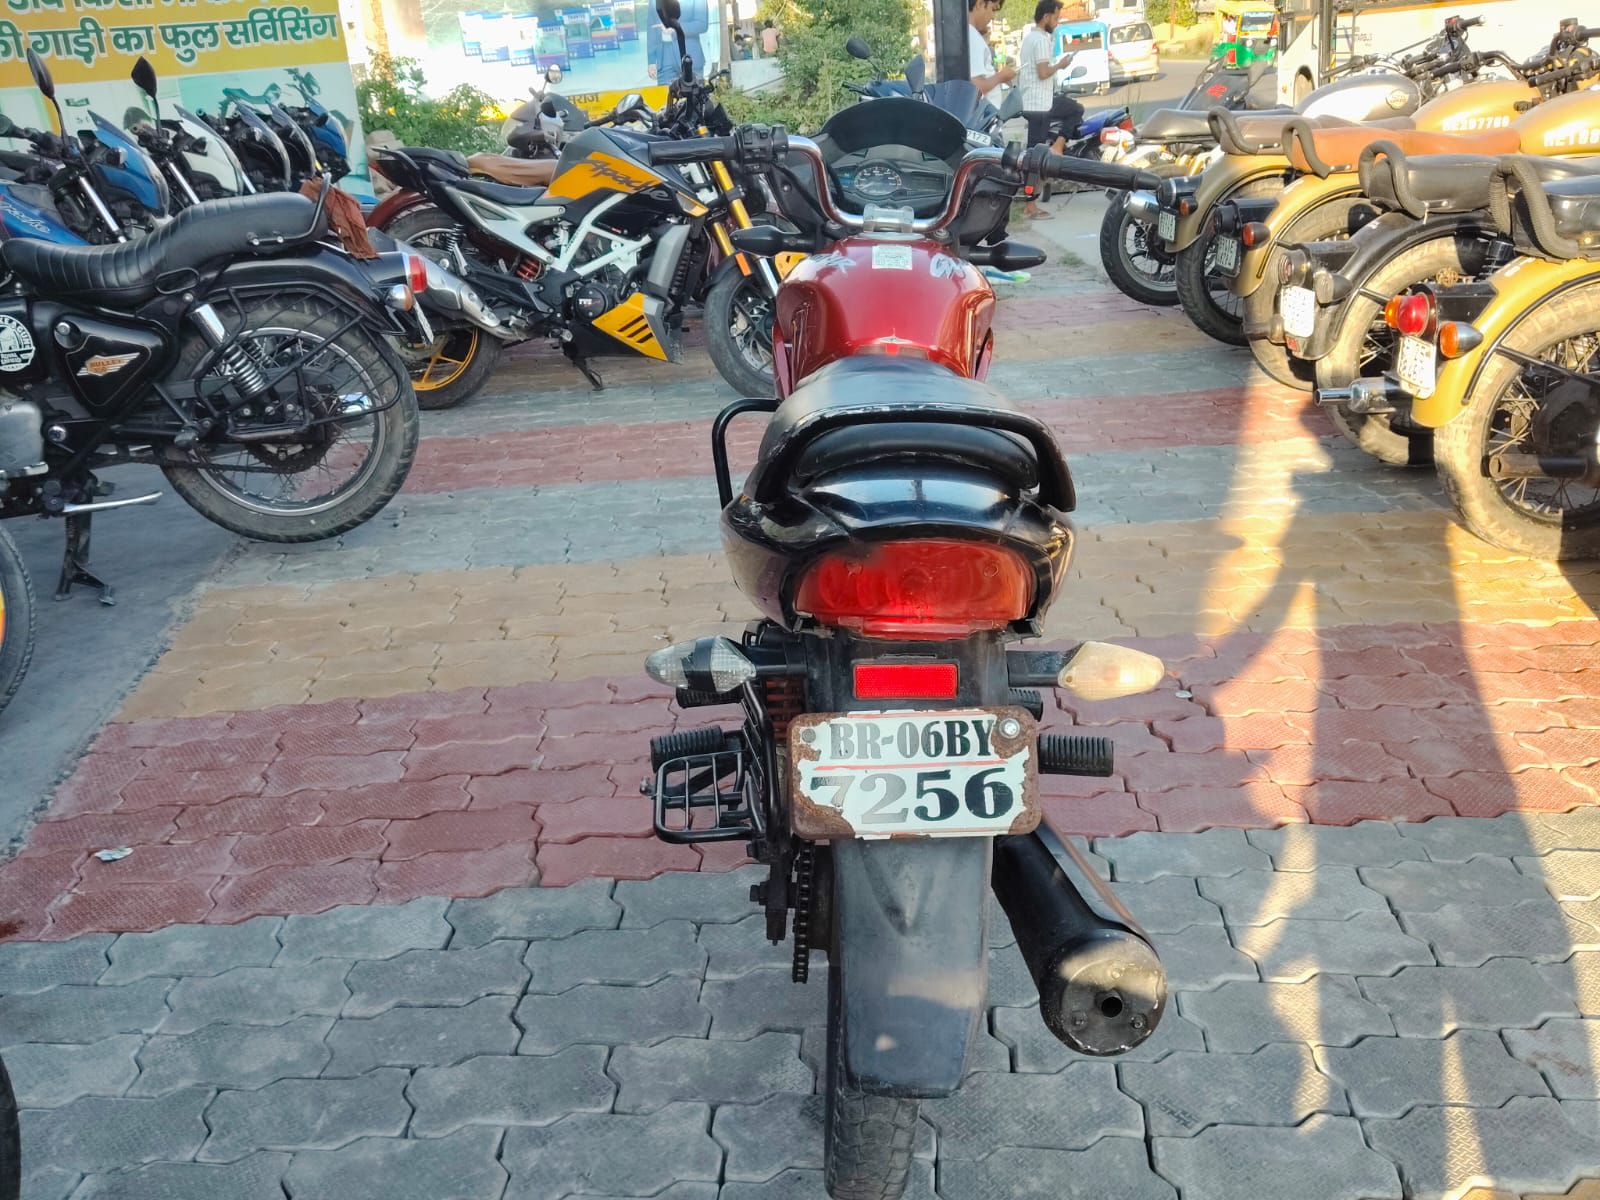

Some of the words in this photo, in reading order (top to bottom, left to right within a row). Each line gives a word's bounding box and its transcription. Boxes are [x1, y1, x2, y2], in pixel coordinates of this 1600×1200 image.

[28, 17, 105, 64] गाड़ी
[110, 26, 154, 51] का
[159, 22, 219, 62] फुल
[224, 7, 337, 44] सर्विसिंग
[828, 719, 995, 760] BR-06BY
[810, 767, 1014, 824] 7256
